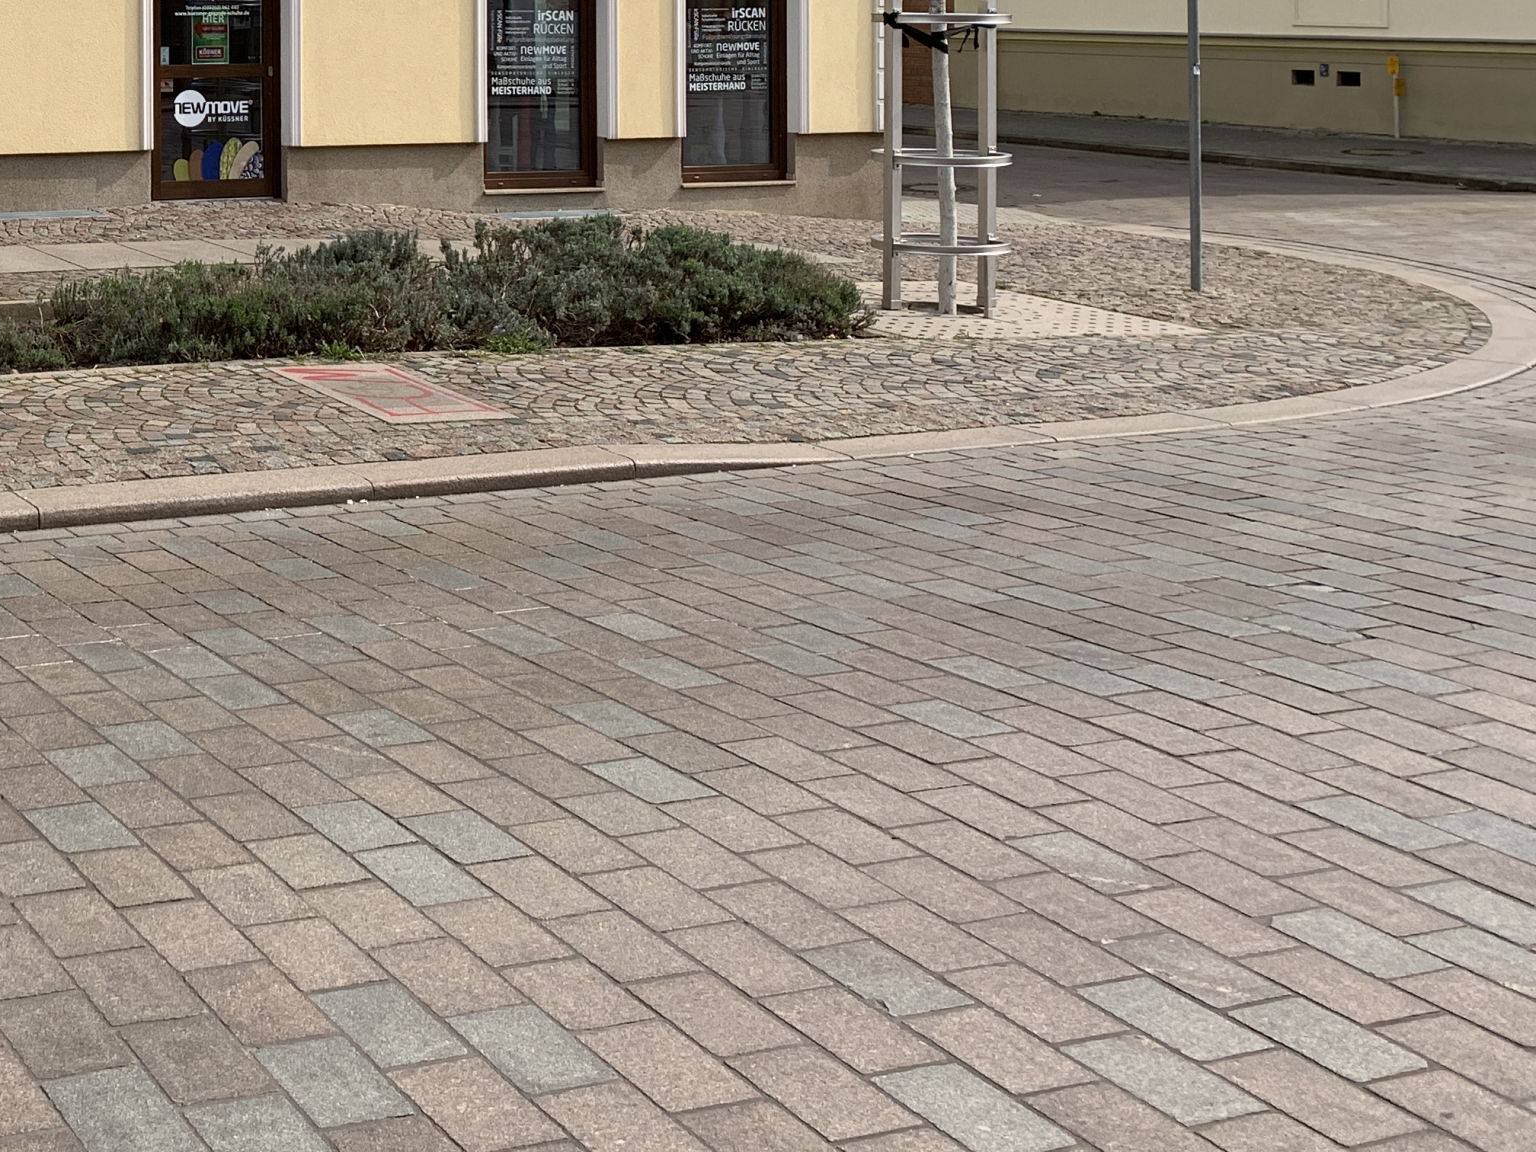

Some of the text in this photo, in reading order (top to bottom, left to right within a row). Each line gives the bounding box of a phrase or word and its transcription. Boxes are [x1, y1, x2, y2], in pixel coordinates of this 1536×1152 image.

[538, 10, 574, 21] irSCAN
[731, 7, 766, 18] irSCAN
[533, 21, 574, 34] RÜCKEN
[728, 19, 766, 31] RÜCKEN
[521, 46, 566, 55] newMOVE
[716, 42, 759, 51] newMOVE
[491, 77, 536, 85] Maßschuhe
[689, 73, 731, 81] Maßschuhe
[491, 86, 552, 95] MEISTERHAND
[689, 82, 746, 91] MEISTERHAND
